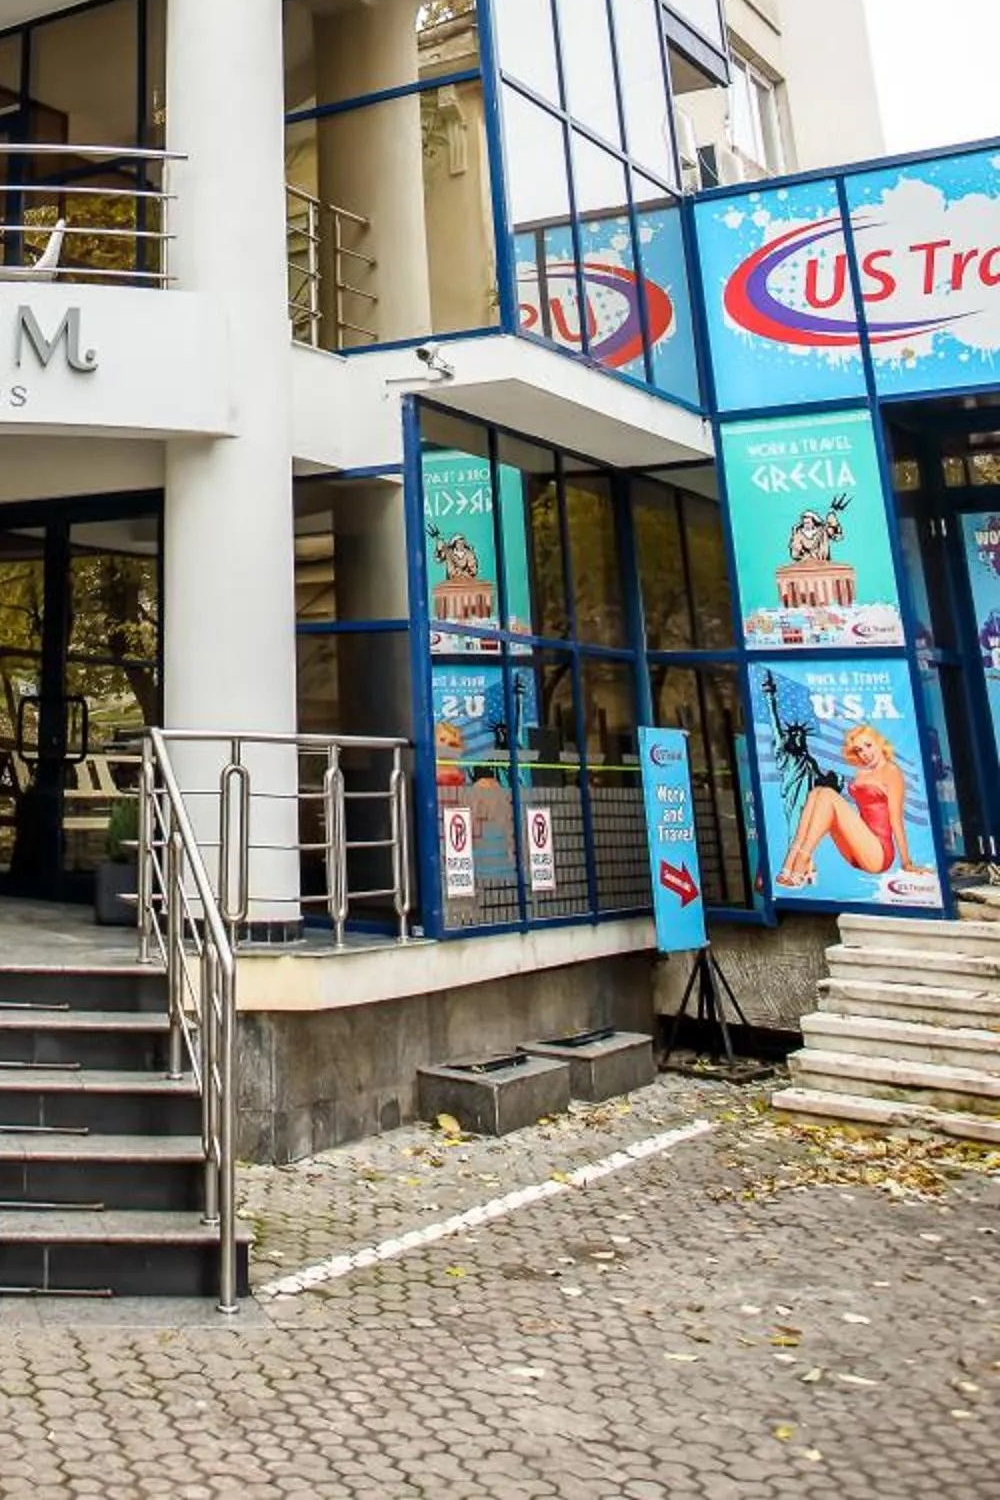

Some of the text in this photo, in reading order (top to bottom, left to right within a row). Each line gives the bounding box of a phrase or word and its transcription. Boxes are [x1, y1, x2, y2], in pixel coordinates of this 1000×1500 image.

[804, 249, 896, 309] US
[802, 435, 853, 453] TRAVEL
[752, 459, 857, 493] GRECIA
[852, 671, 890, 685] Travel
[657, 785, 686, 803] Work
[663, 806, 684, 822] and
[658, 824, 695, 843] Travel
